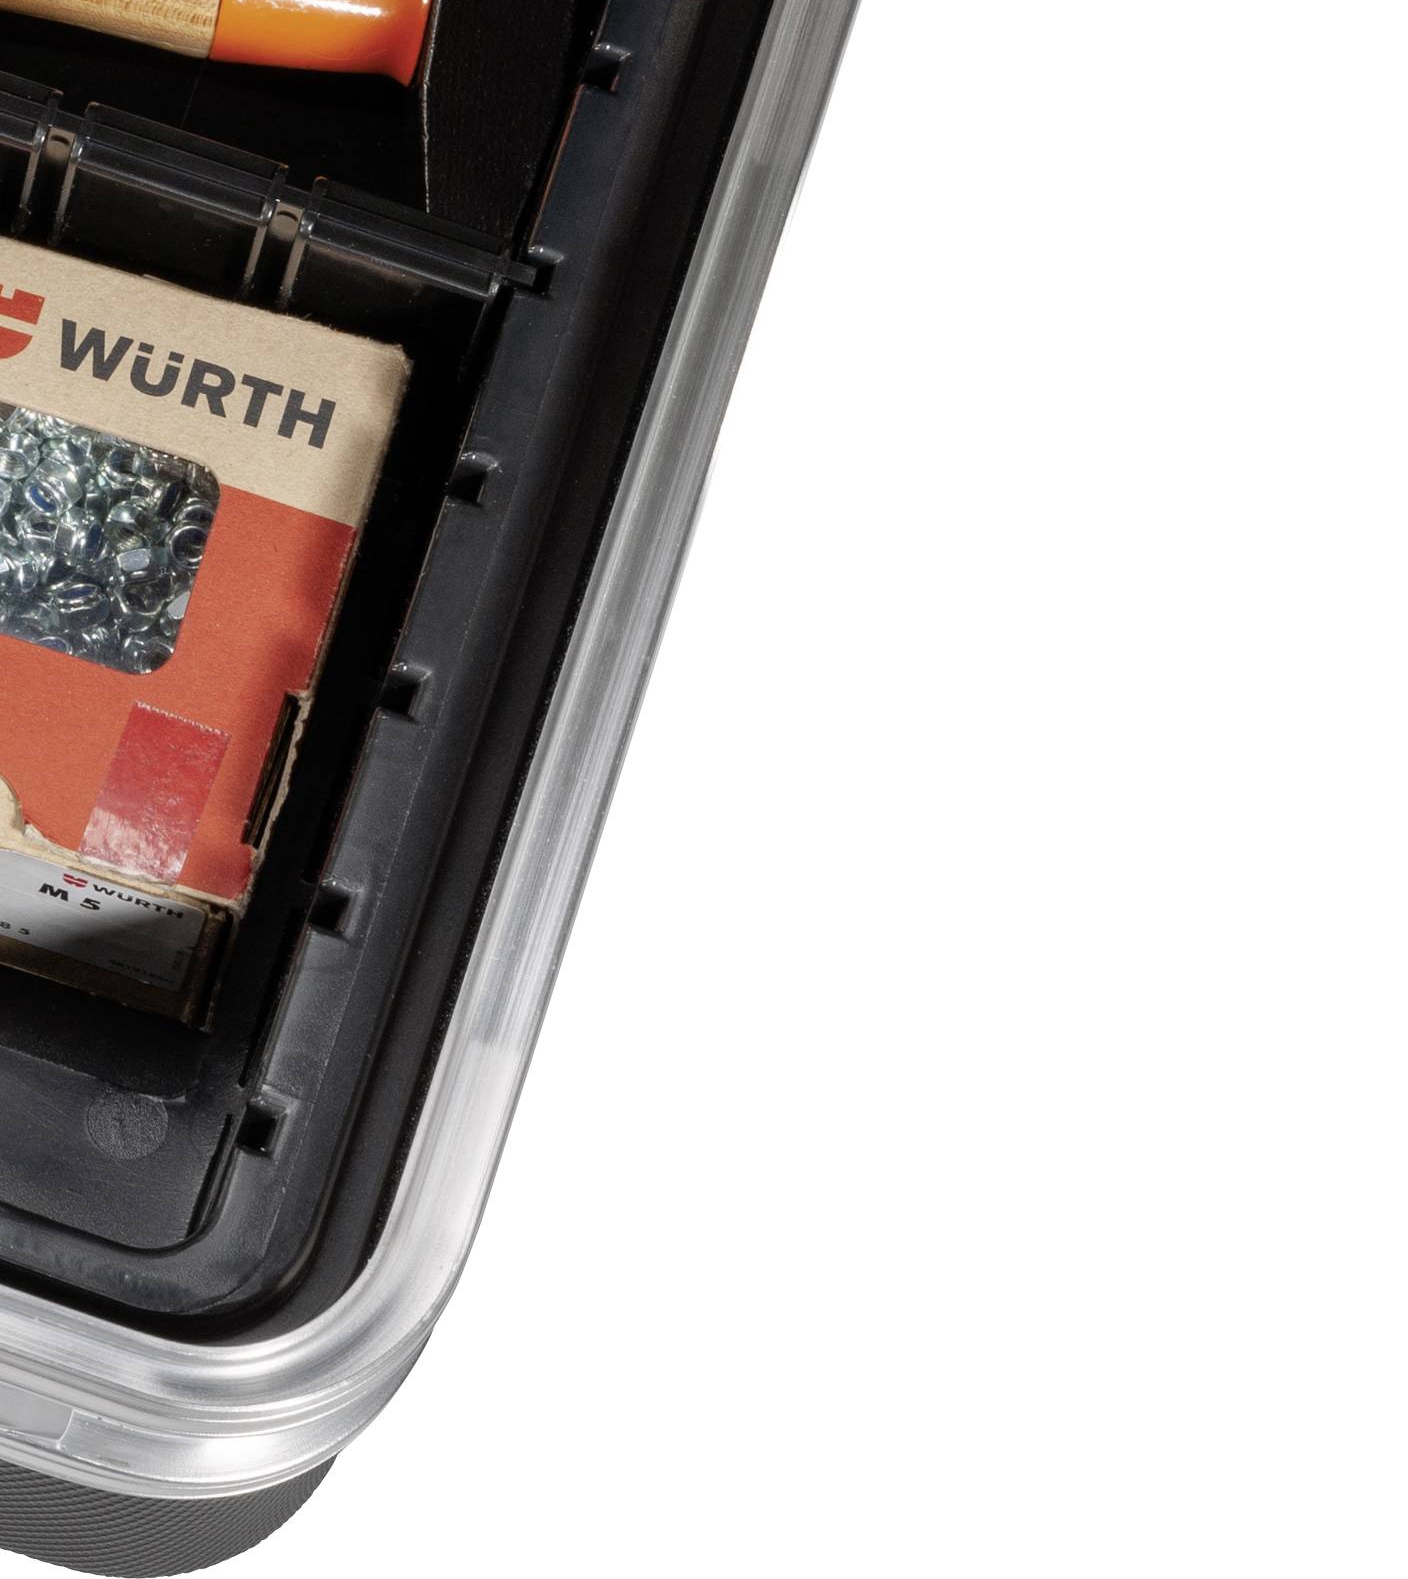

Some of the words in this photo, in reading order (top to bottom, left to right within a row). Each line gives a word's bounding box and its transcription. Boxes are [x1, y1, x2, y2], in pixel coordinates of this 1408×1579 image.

[60, 318, 336, 449] WÜRTH
[38, 881, 71, 902] M
[79, 895, 102, 912] 5
